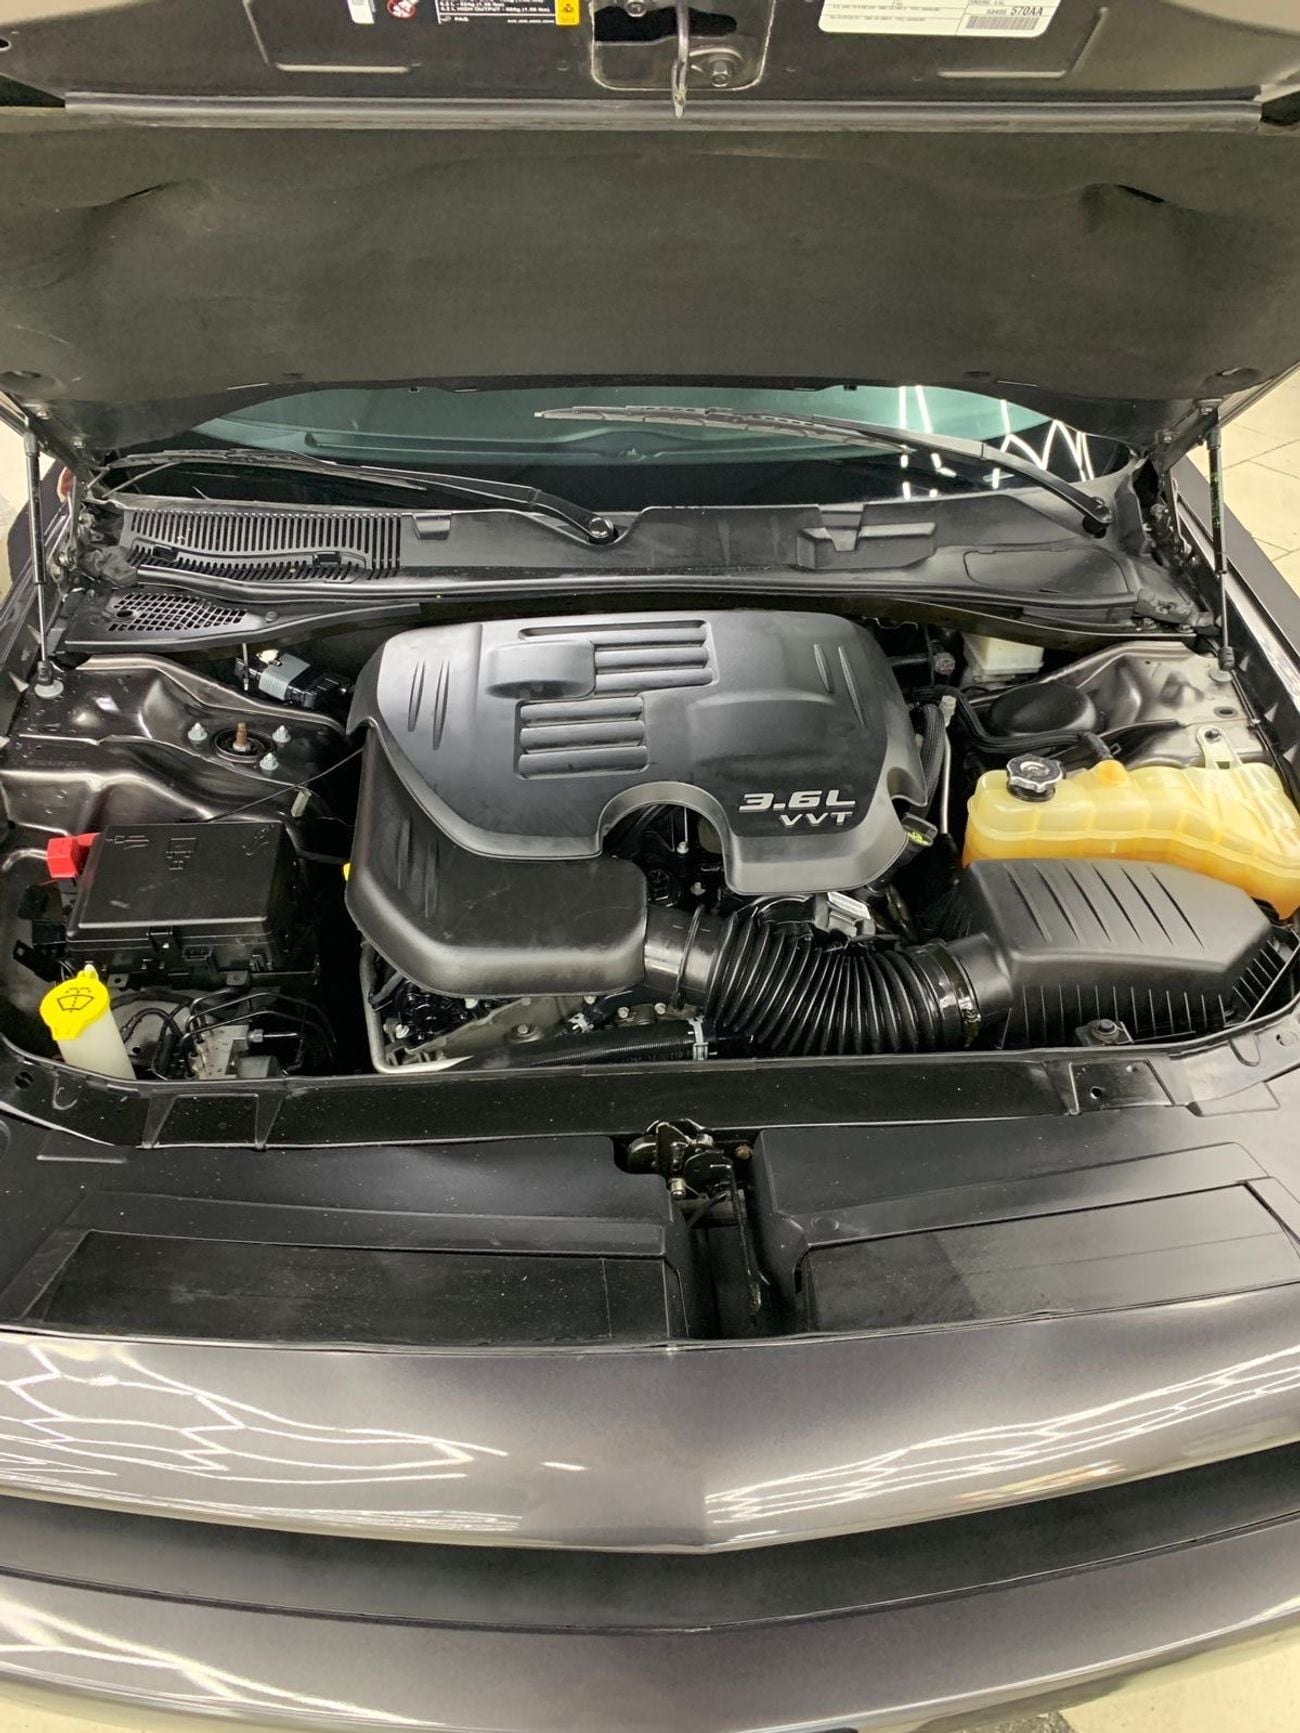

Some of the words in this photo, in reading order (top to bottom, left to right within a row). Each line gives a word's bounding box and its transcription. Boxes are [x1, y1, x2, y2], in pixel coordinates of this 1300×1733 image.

[1010, 6, 1044, 16] 570AA
[739, 790, 856, 812] 3.6L
[780, 811, 853, 828] VVT
